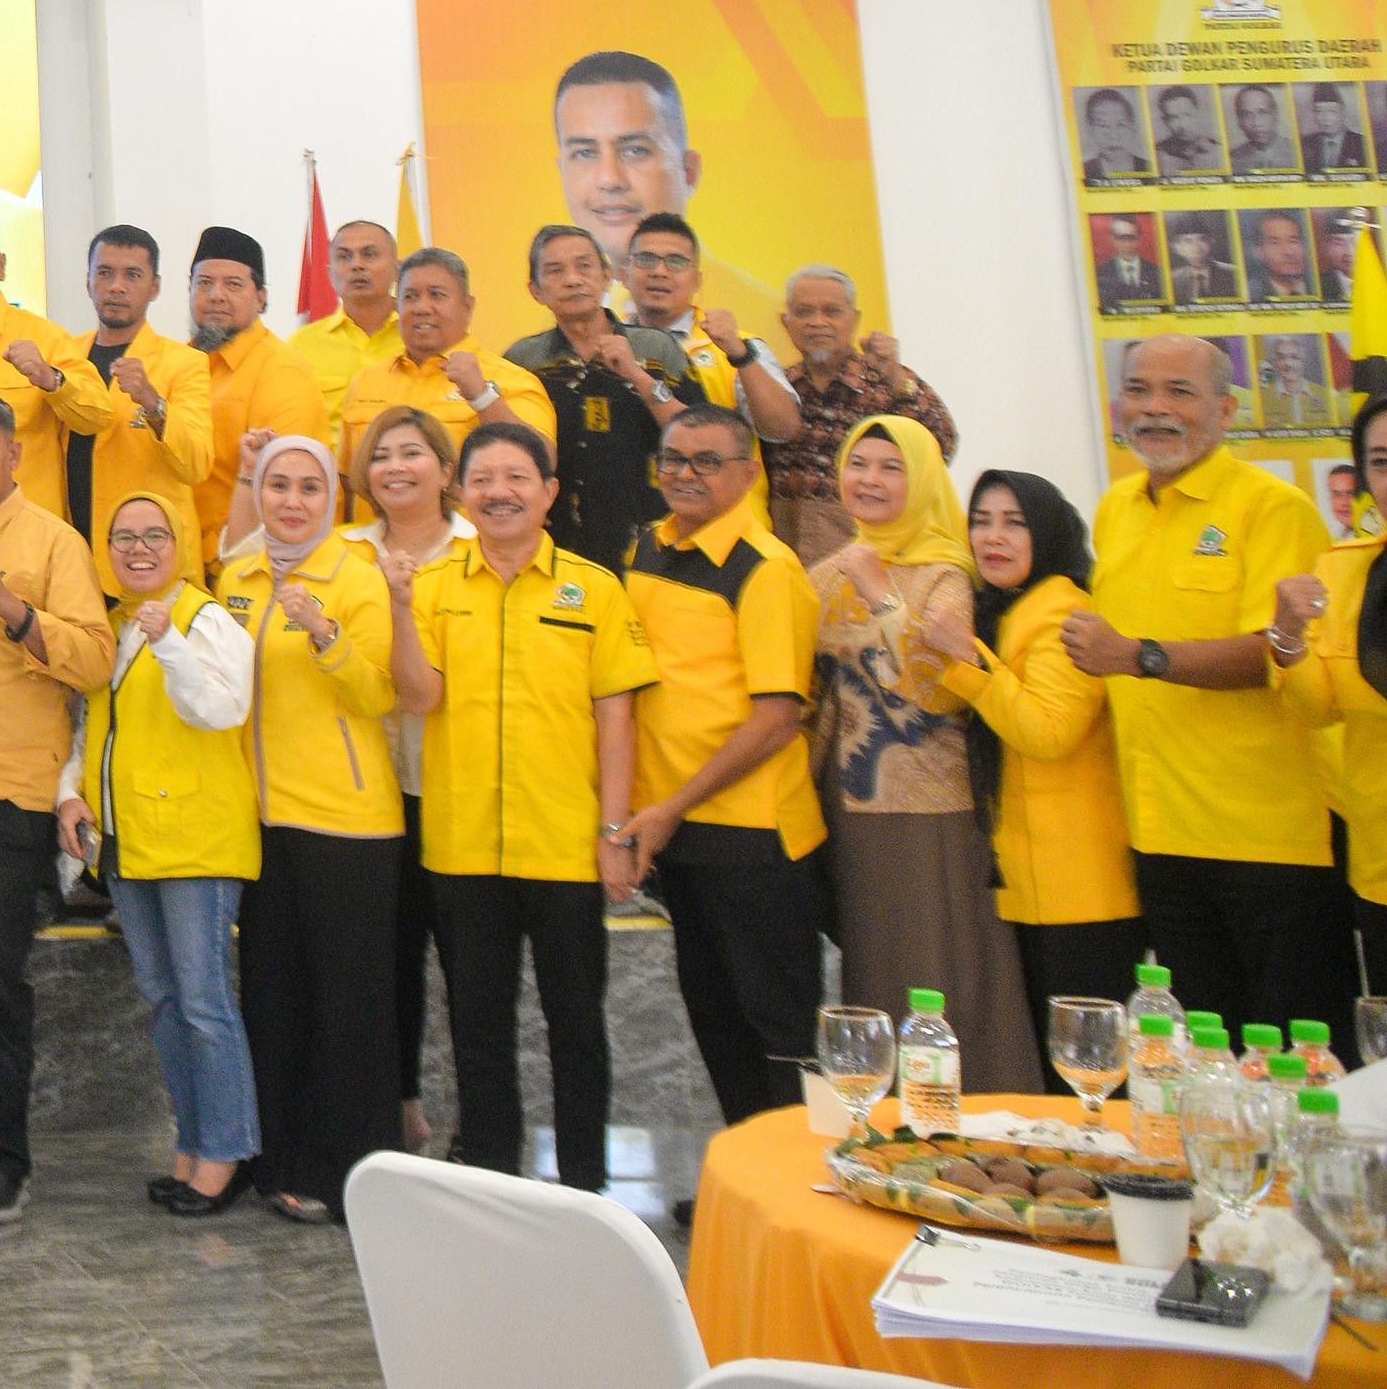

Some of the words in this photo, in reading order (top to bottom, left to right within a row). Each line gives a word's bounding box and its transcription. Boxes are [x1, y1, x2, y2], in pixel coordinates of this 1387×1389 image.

[1111, 42, 1162, 58] KETUA
[1167, 41, 1222, 57] DEWAN
[1228, 40, 1312, 55] PENGURUS
[1318, 38, 1382, 53] DAERAH
[1128, 59, 1178, 72] PARTAI
[1182, 58, 1239, 72] GOLKAR
[1243, 57, 1322, 70] SUMATERA
[1325, 55, 1371, 69] UTARA
